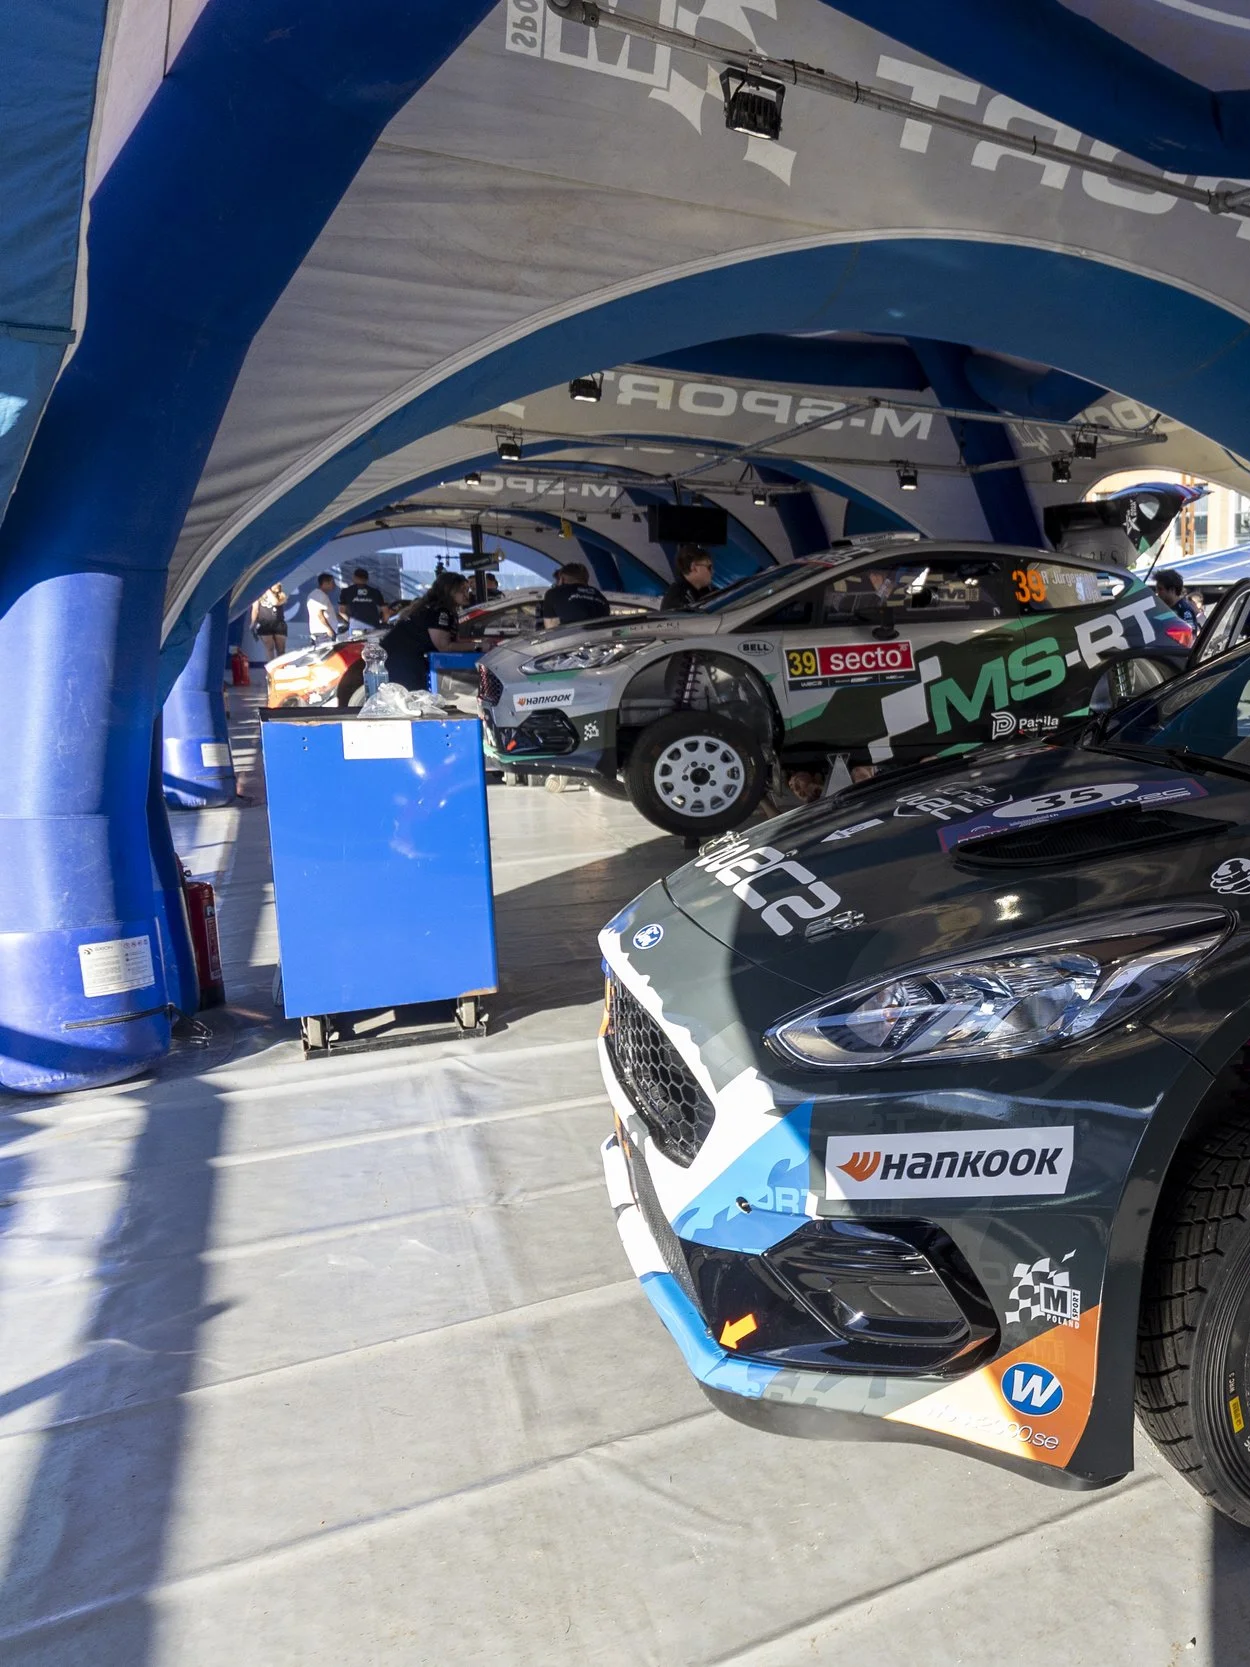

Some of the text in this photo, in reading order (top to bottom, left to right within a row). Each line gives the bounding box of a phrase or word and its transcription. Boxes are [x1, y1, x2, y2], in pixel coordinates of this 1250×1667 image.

[1012, 569, 1047, 604] 39
[742, 643, 771, 652] BELL
[829, 646, 902, 672] secto
[788, 650, 817, 676] 39
[930, 596, 1159, 735] MS-RT
[1030, 787, 1104, 812] 35
[1071, 1291, 1079, 1319] SPORT
[1046, 1314, 1080, 1329] POLAND
[1012, 1369, 1061, 1408] W
